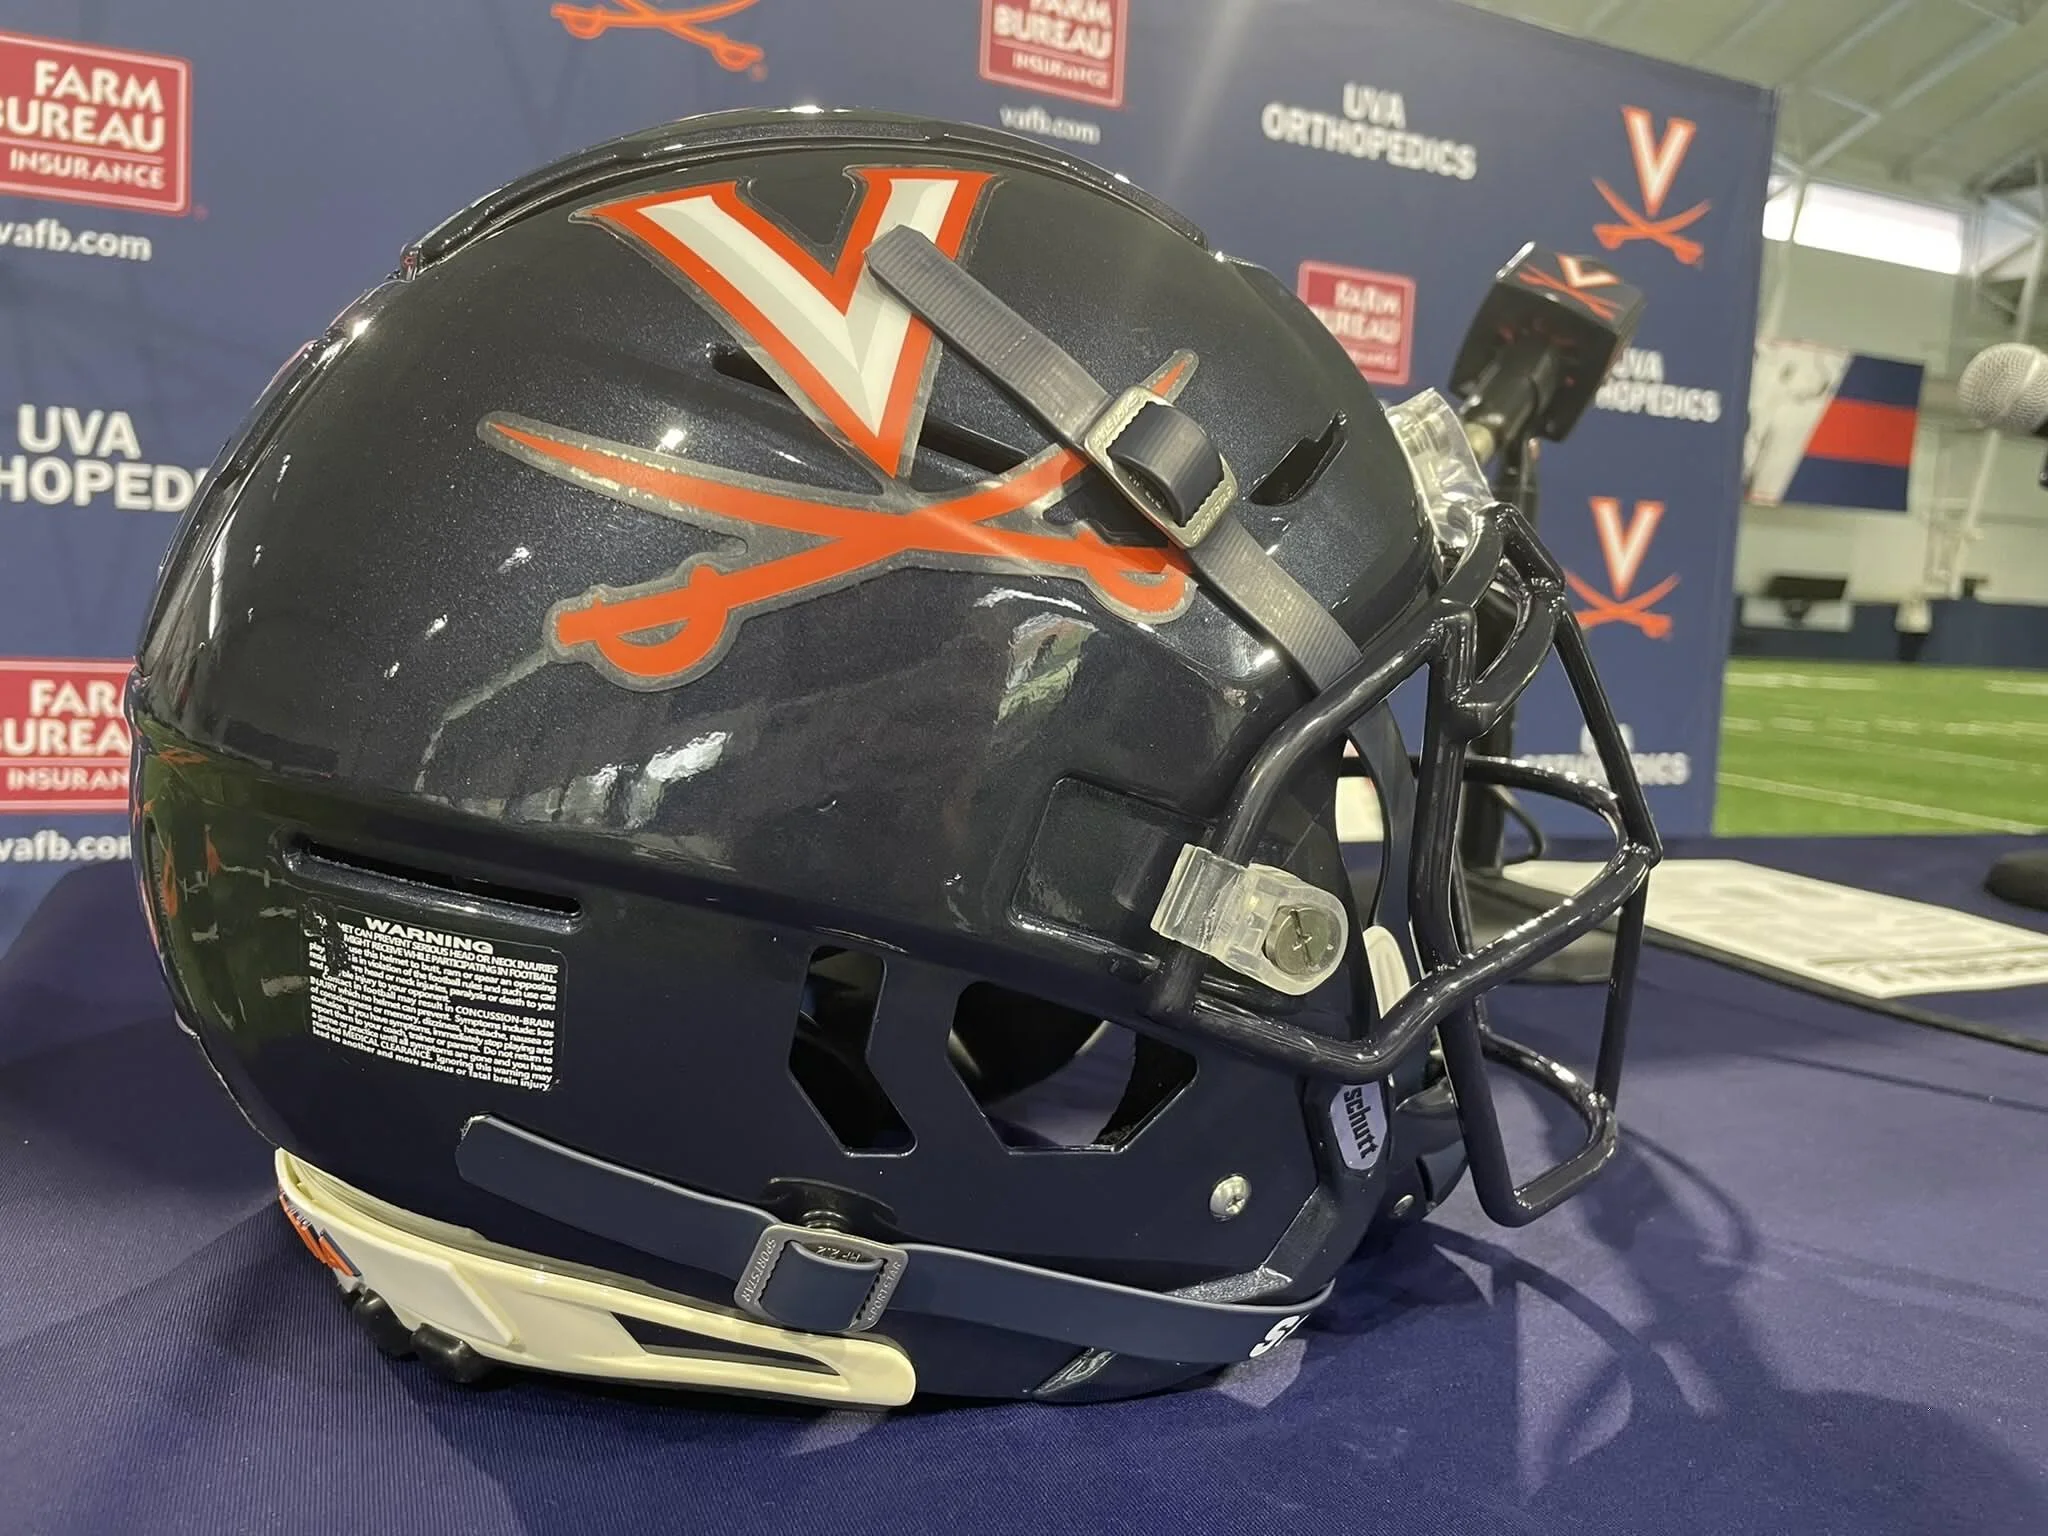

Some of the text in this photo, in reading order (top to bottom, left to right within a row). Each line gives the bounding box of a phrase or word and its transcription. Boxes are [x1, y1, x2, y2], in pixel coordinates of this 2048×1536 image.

[993, 4, 1112, 60] BUREAU
[34, 59, 164, 114] FARM
[1342, 82, 1405, 128] UVA
[0, 96, 166, 153] UREAU
[1262, 103, 1477, 180] ORTHOPEDICS
[9, 148, 166, 190] INSURANCE
[18, 403, 142, 460] UVA
[0, 454, 209, 512] HOPED
[30, 678, 126, 717] FAR
[0, 717, 131, 757] UREA
[7, 766, 129, 792] INSURAN
[343, 933, 370, 948] MIGHT
[372, 940, 402, 956] RECEIVE
[403, 948, 430, 962] WHILE
[431, 954, 496, 974] PARTICIPATING
[497, 966, 507, 976] IN
[354, 926, 558, 974] CAN PREVENT SERIOUS HEAD OR NECK INJURIES
[365, 916, 494, 955] WARNING
[309, 958, 323, 970] and
[354, 972, 376, 988] injury
[377, 979, 386, 988] to
[387, 983, 406, 995] your
[348, 945, 556, 995] use this helmet to butt, ram or spear an opposing
[352, 953, 556, 1002] is in violation of the football rules and such use can
[364, 966, 383, 979] head
[385, 973, 394, 981] or
[395, 974, 414, 986] neck
[449, 985, 486, 1002] paralysis
[499, 994, 524, 1007] death
[526, 1000, 536, 1009] to
[537, 1003, 555, 1014] you
[310, 984, 318, 994] of
[319, 987, 372, 1010] consciousness
[373, 1005, 382, 1013] or
[383, 1008, 420, 1024] memory,
[463, 1024, 507, 1042] headache,
[509, 1035, 541, 1046] nausea
[338, 984, 360, 998] which
[361, 993, 372, 1002] no
[373, 994, 400, 1009] helmet
[401, 1003, 415, 1013] can
[454, 1013, 500, 1032] Symptoms
[537, 1028, 554, 1039] loss
[353, 980, 361, 990] in
[363, 983, 395, 999] football
[397, 994, 416, 1006] may
[418, 996, 443, 1010] result
[444, 1002, 453, 1012] in
[455, 1004, 554, 1030] CONCUSSION-BRAIN
[311, 1002, 332, 1017] report
[334, 1009, 353, 1022] them
[354, 1016, 363, 1025] to
[363, 1020, 381, 1032] your
[408, 1029, 435, 1043] trainer
[436, 1038, 445, 1046] or
[483, 1046, 496, 1056] Do
[498, 1050, 512, 1059] not
[514, 1052, 541, 1063] return
[542, 1057, 552, 1065] to
[312, 1019, 341, 1035] reached
[342, 1029, 378, 1046] MEDICAL
[436, 1054, 473, 1070] Ignoring
[475, 1062, 491, 1072] this
[493, 1066, 529, 1080] warning
[531, 1074, 552, 1084] may
[312, 1026, 329, 1039] lead
[331, 1033, 340, 1043] to
[342, 1036, 375, 1053] another
[376, 1046, 393, 1058] and
[395, 1053, 418, 1064] more
[420, 1057, 453, 1073] serious
[455, 1067, 466, 1076] or
[468, 1068, 490, 1080] fatal
[493, 1073, 518, 1085] brain
[317, 1014, 338, 1027] game
[339, 1021, 347, 1029] or
[349, 1022, 378, 1039] practice
[379, 1031, 397, 1042] until
[398, 1036, 408, 1045] all
[409, 1040, 453, 1057] symptoms
[454, 1051, 468, 1059] are
[469, 1054, 492, 1065] gone
[493, 1057, 510, 1067] and
[512, 1062, 529, 1071] you
[530, 1063, 552, 1074] have
[354, 1008, 369, 1020] you
[370, 1011, 388, 1024] have
[433, 1026, 483, 1047] immediately
[483, 1038, 502, 1050] stop
[503, 1040, 534, 1056] playing
[536, 1046, 552, 1057] and
[741, 1238, 777, 1303] SPORTSTAR
[867, 1261, 902, 1323] SPORTSTAR
